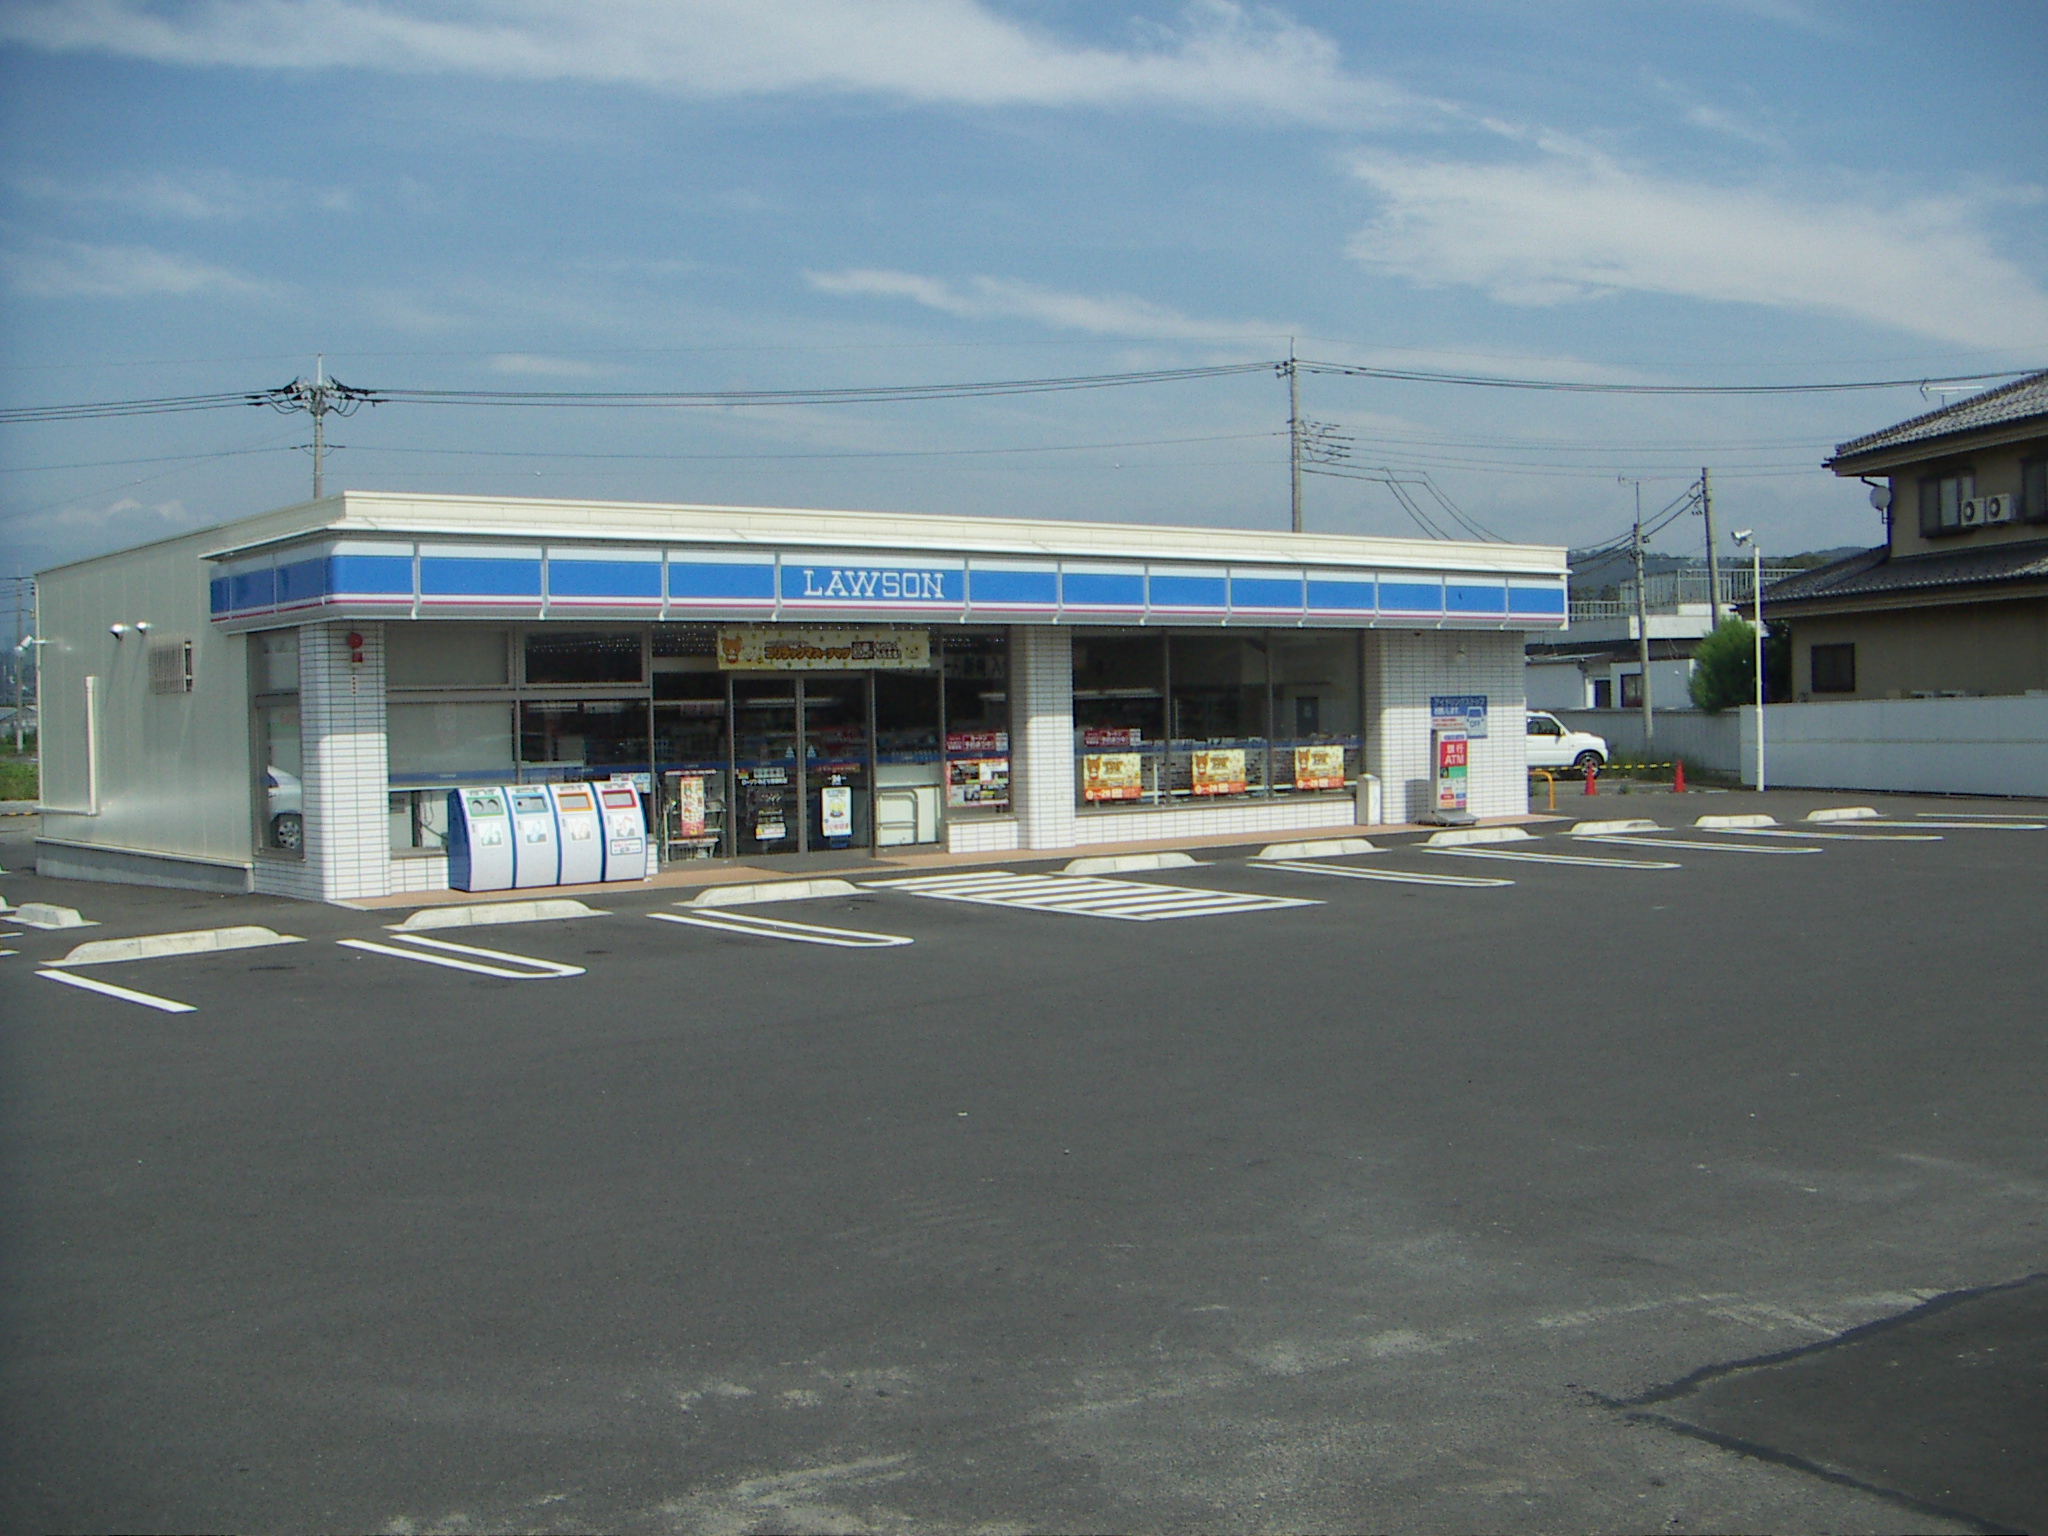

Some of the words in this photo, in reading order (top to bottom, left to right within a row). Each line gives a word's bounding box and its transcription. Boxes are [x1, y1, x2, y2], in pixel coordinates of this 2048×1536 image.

[803, 569, 945, 599] LAWSON
[1447, 743, 1465, 754] 銀行
[1445, 755, 1465, 765] ATM
